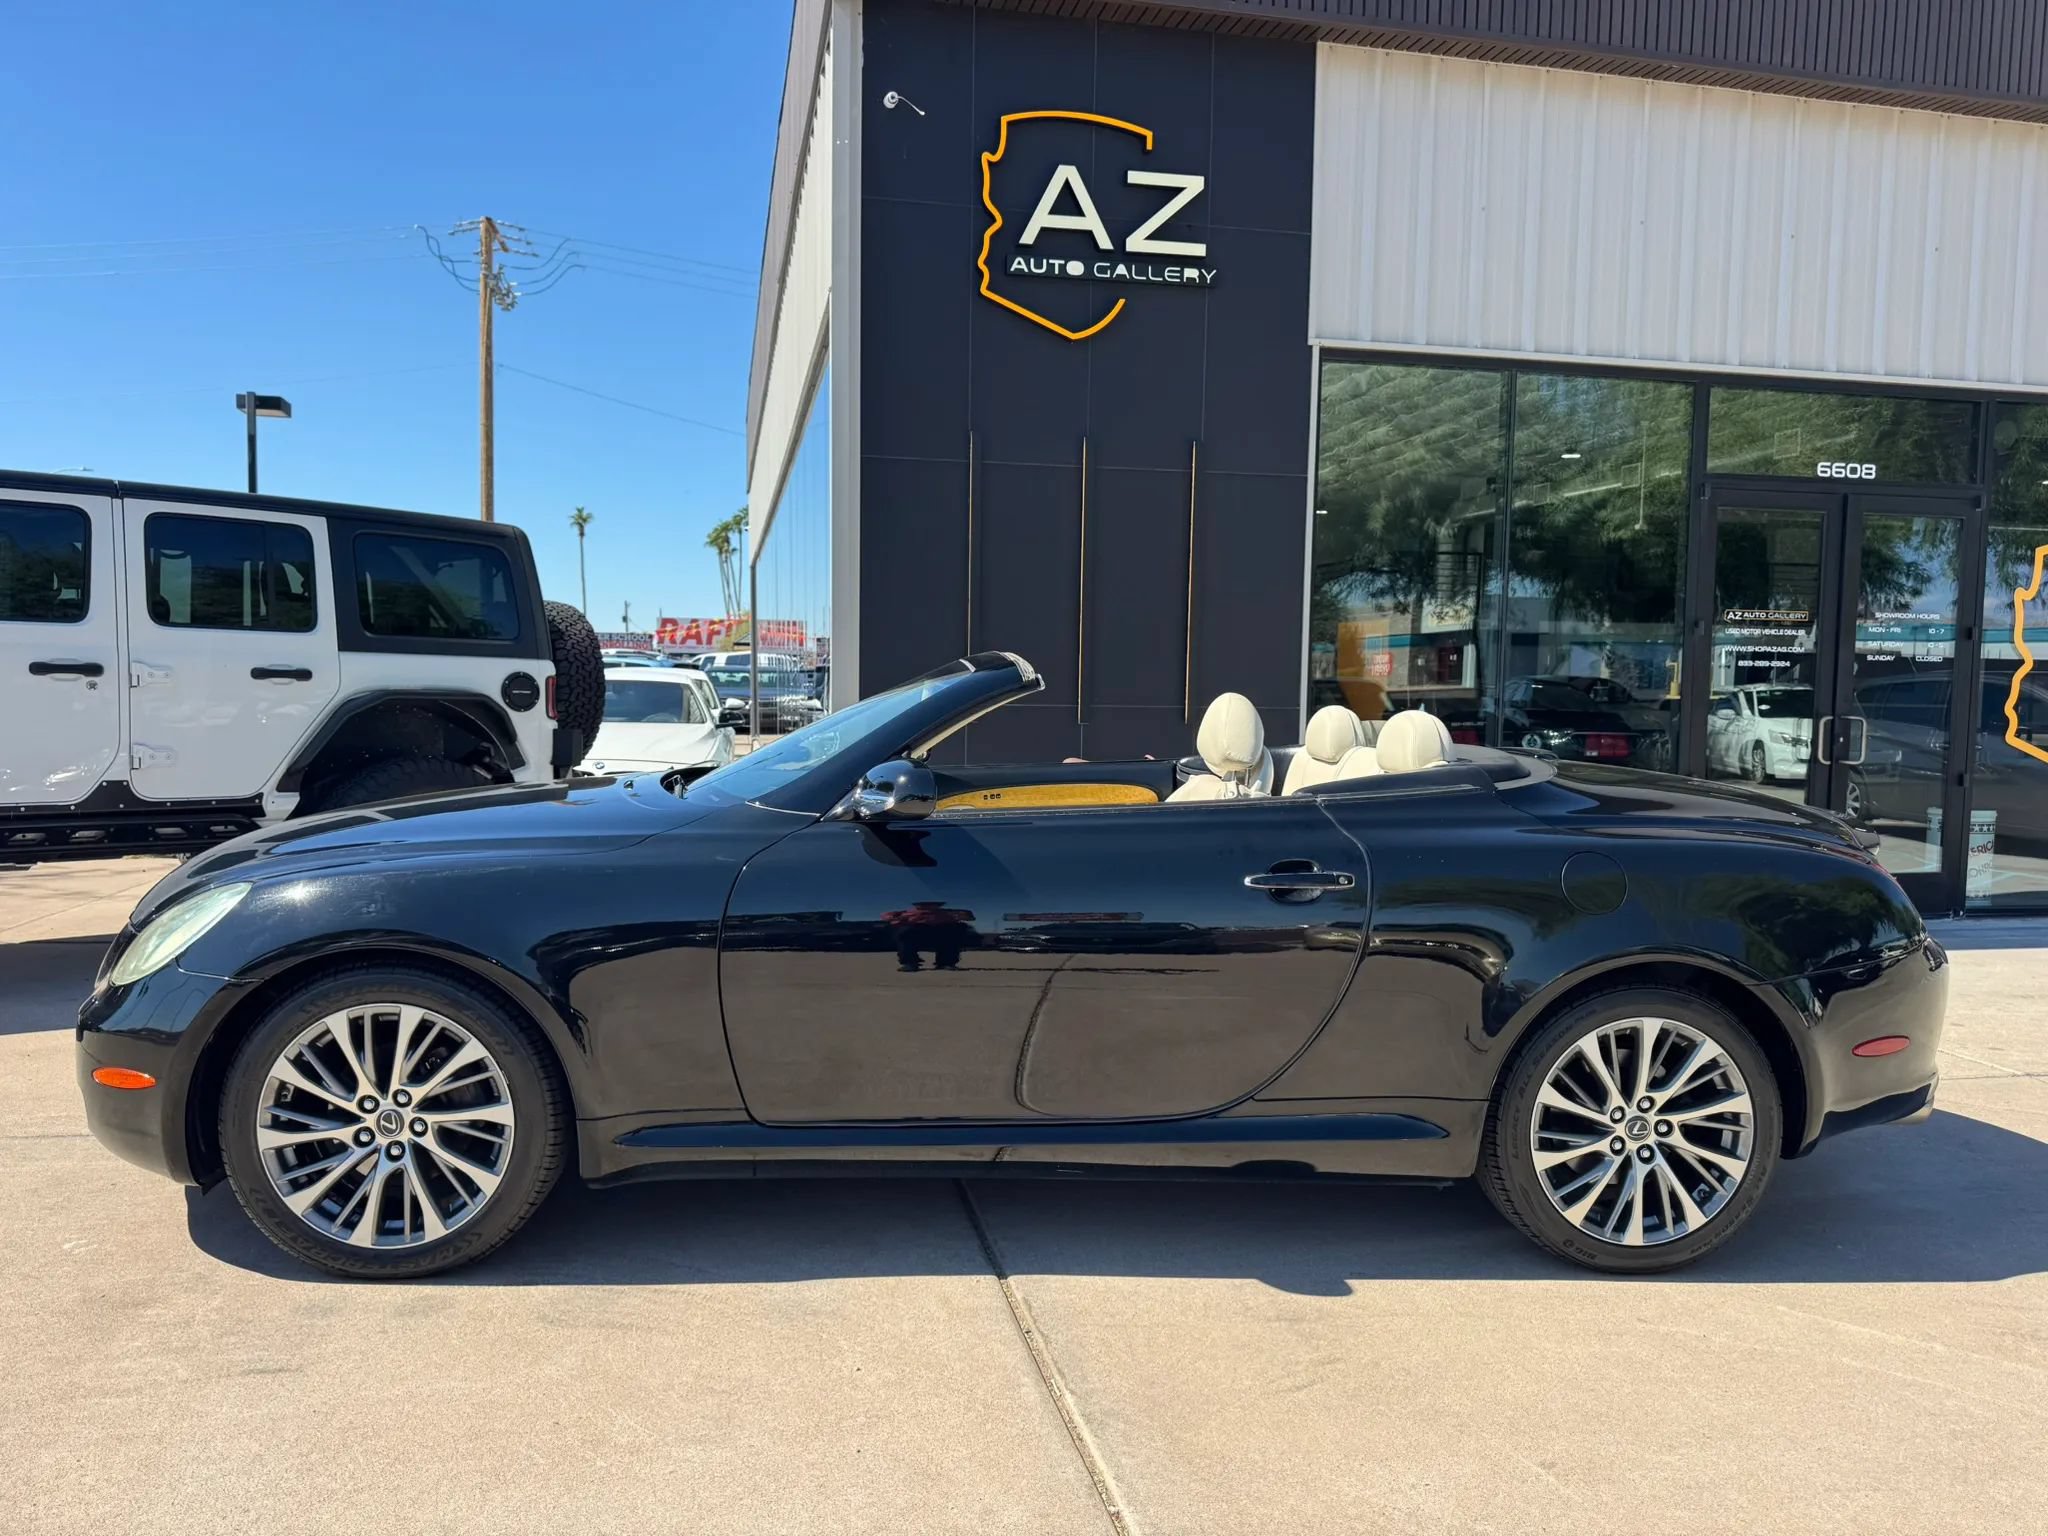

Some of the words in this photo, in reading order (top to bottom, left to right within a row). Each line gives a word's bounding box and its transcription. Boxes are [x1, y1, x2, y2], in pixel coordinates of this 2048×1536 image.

[1018, 164, 1207, 257] AZ
[1010, 256, 1085, 276] AUTO
[1093, 262, 1217, 284] GALLERY
[1817, 462, 1876, 479] 6608
[1727, 611, 1743, 620] AZ
